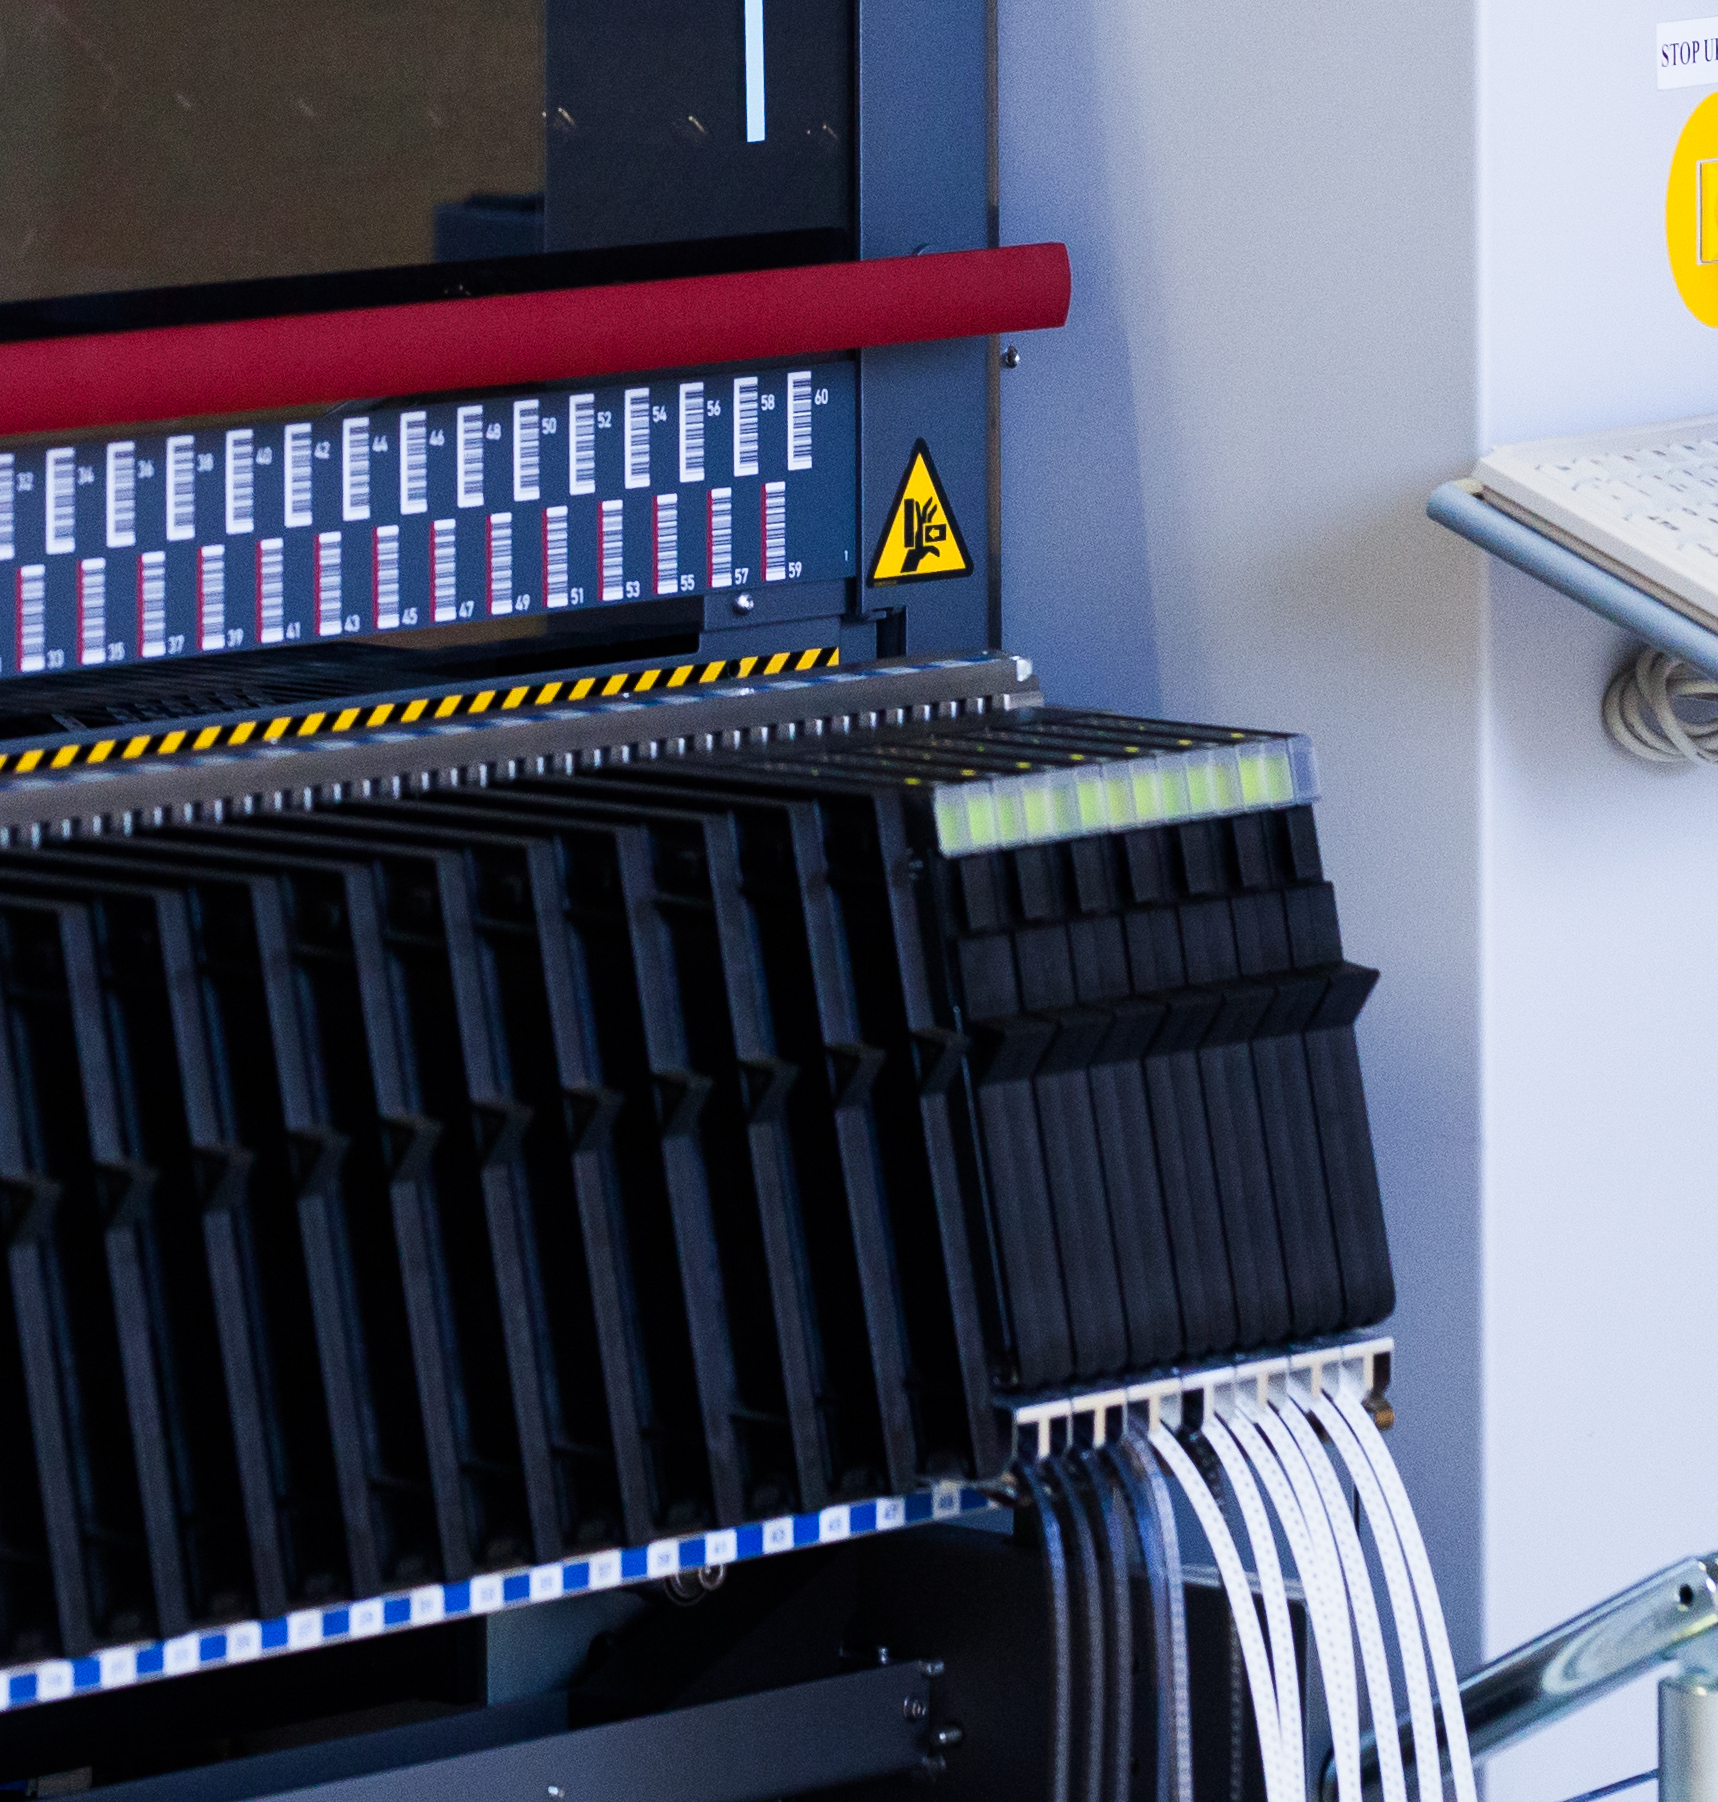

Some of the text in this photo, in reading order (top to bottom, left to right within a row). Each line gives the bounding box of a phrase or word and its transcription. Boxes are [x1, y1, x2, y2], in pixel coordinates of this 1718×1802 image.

[1661, 40, 1700, 67] STOP
[760, 394, 775, 411] 58
[814, 388, 829, 405] 60
[652, 406, 667, 423] 54
[707, 400, 721, 417] 56
[541, 417, 557, 434] 50
[597, 411, 612, 429] 52
[429, 429, 445, 446] 46
[486, 423, 502, 440] 48
[314, 440, 331, 459] 42
[372, 435, 389, 452] 44
[197, 453, 214, 472] 38
[256, 446, 273, 465] 40
[77, 466, 95, 485] 34
[137, 459, 155, 479] 36
[734, 568, 749, 585] 57
[788, 562, 802, 579] 59
[625, 581, 641, 598] 53
[680, 574, 695, 592] 55
[515, 594, 530, 611] 49
[570, 588, 584, 605] 51
[402, 607, 418, 625] 45
[458, 600, 474, 618] 47
[285, 621, 301, 640] 41
[344, 614, 360, 633] 43
[167, 635, 184, 655] 37
[227, 628, 244, 648] 39
[107, 642, 125, 662] 35
